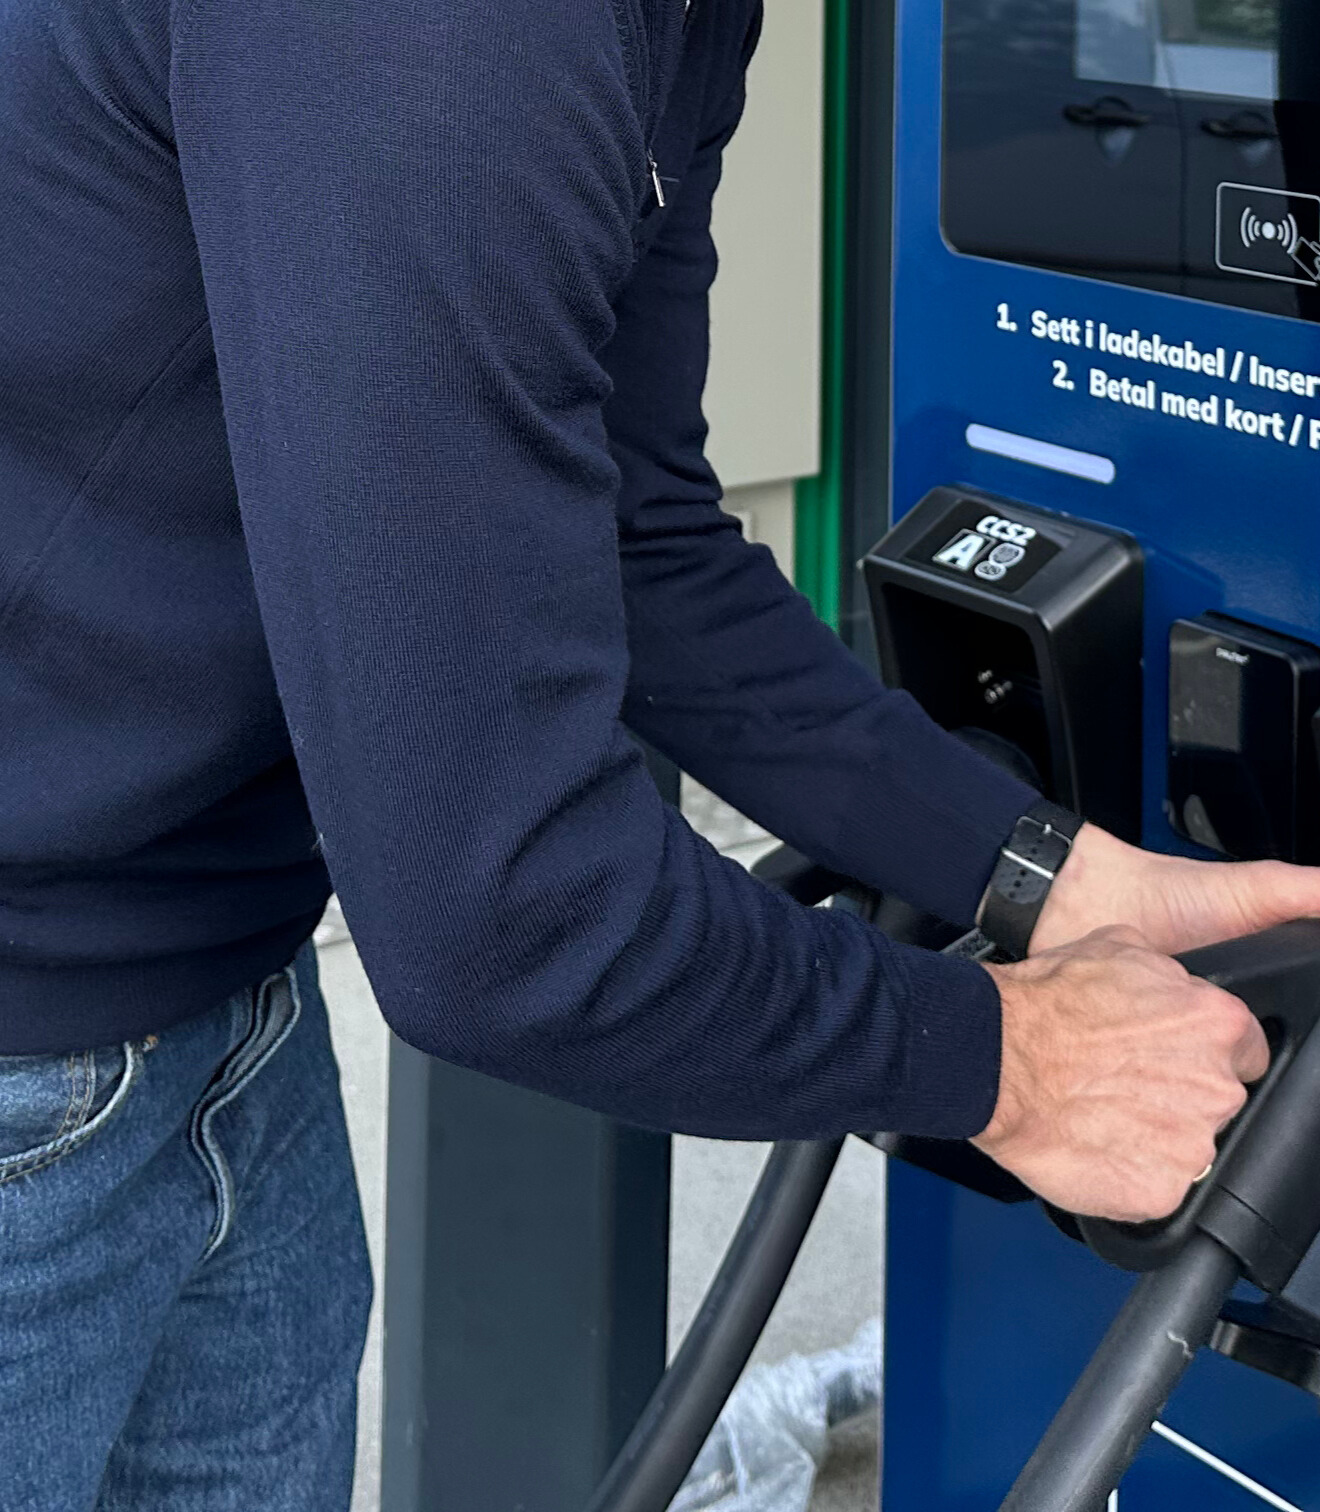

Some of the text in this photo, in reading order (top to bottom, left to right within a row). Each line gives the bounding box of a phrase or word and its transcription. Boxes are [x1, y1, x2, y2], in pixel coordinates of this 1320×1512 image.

[996, 303, 1018, 332] 1.
[1031, 310, 1081, 346] Sett
[1085, 319, 1094, 349] i
[1099, 322, 1225, 378] ladekabel
[1229, 351, 1244, 383] /
[1052, 359, 1076, 391] 2.
[1089, 368, 1155, 410] Betal
[1161, 391, 1219, 425] med
[1225, 398, 1285, 442] kort
[1288, 413, 1304, 446] /
[938, 533, 984, 571] A
[976, 515, 1037, 546] CCS2
